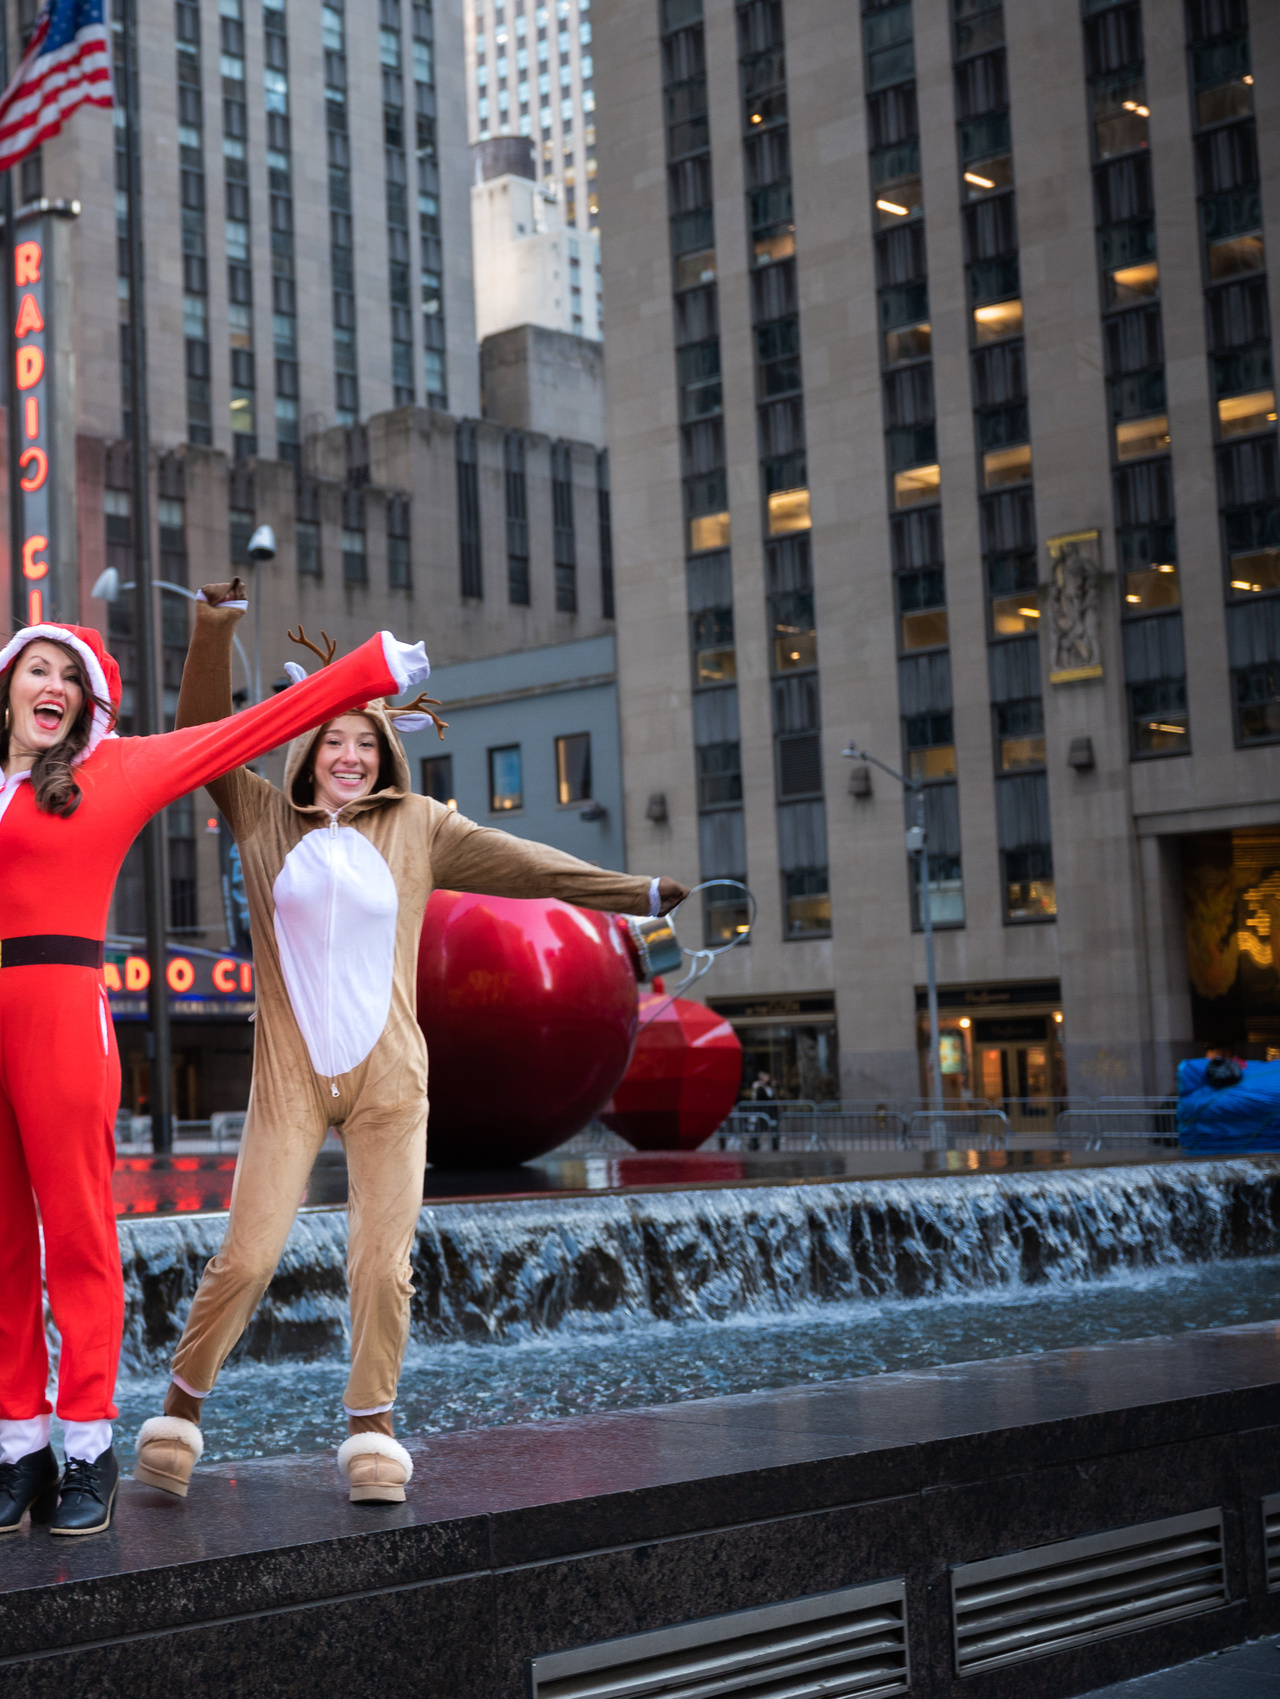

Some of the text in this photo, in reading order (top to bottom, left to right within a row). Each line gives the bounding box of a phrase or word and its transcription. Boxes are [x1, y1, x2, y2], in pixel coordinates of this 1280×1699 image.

[15, 241, 48, 491] RADIO
[104, 957, 254, 993] ADO CI
